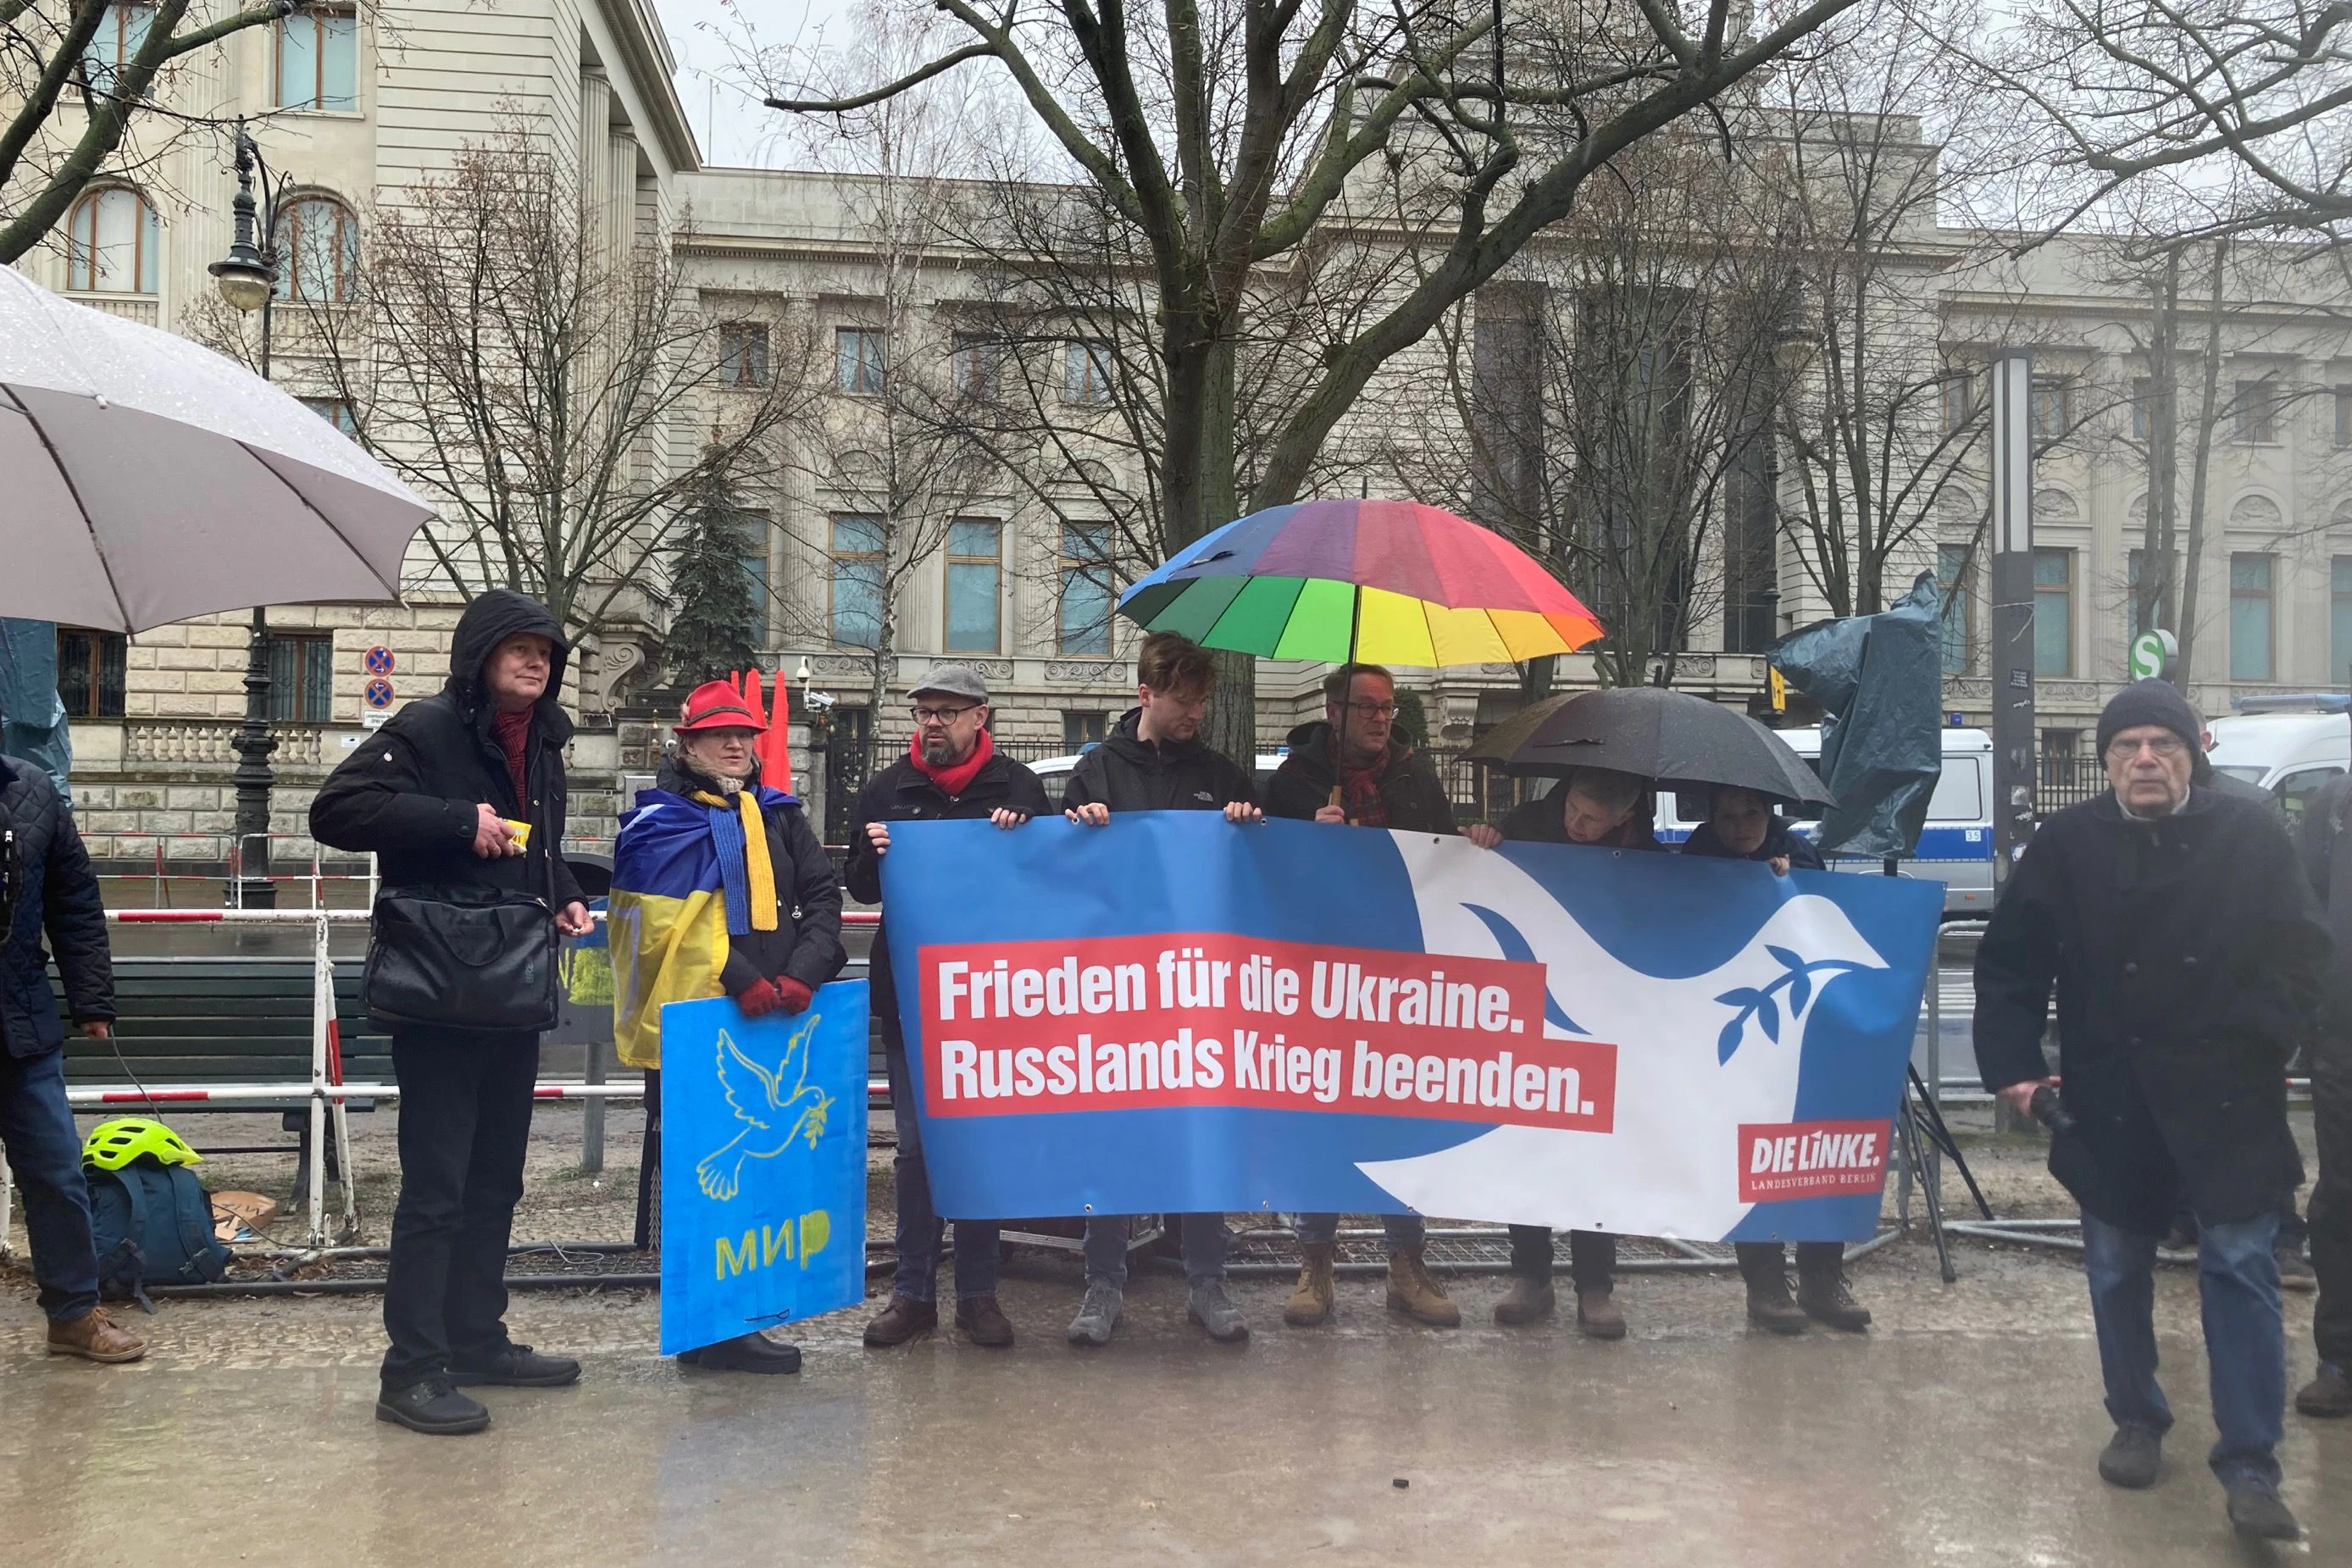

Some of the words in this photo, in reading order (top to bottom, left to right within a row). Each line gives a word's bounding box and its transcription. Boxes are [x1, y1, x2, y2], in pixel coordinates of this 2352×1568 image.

[2136, 635, 2160, 680] S
[1966, 831, 1980, 840] 35
[938, 956, 1146, 1021] Frieden
[1156, 947, 1232, 1012] für
[1239, 954, 1300, 1016] die
[1311, 961, 1524, 1033] Ukraine.
[940, 1027, 1225, 1100] Russlands
[1233, 1028, 1342, 1103] Krieg
[1351, 1039, 1595, 1116] beenden.
[1750, 1136, 1797, 1174] DIE
[1750, 1174, 1837, 1190] LANDESVERBAND
[1839, 1172, 1877, 1184] BERLIN
